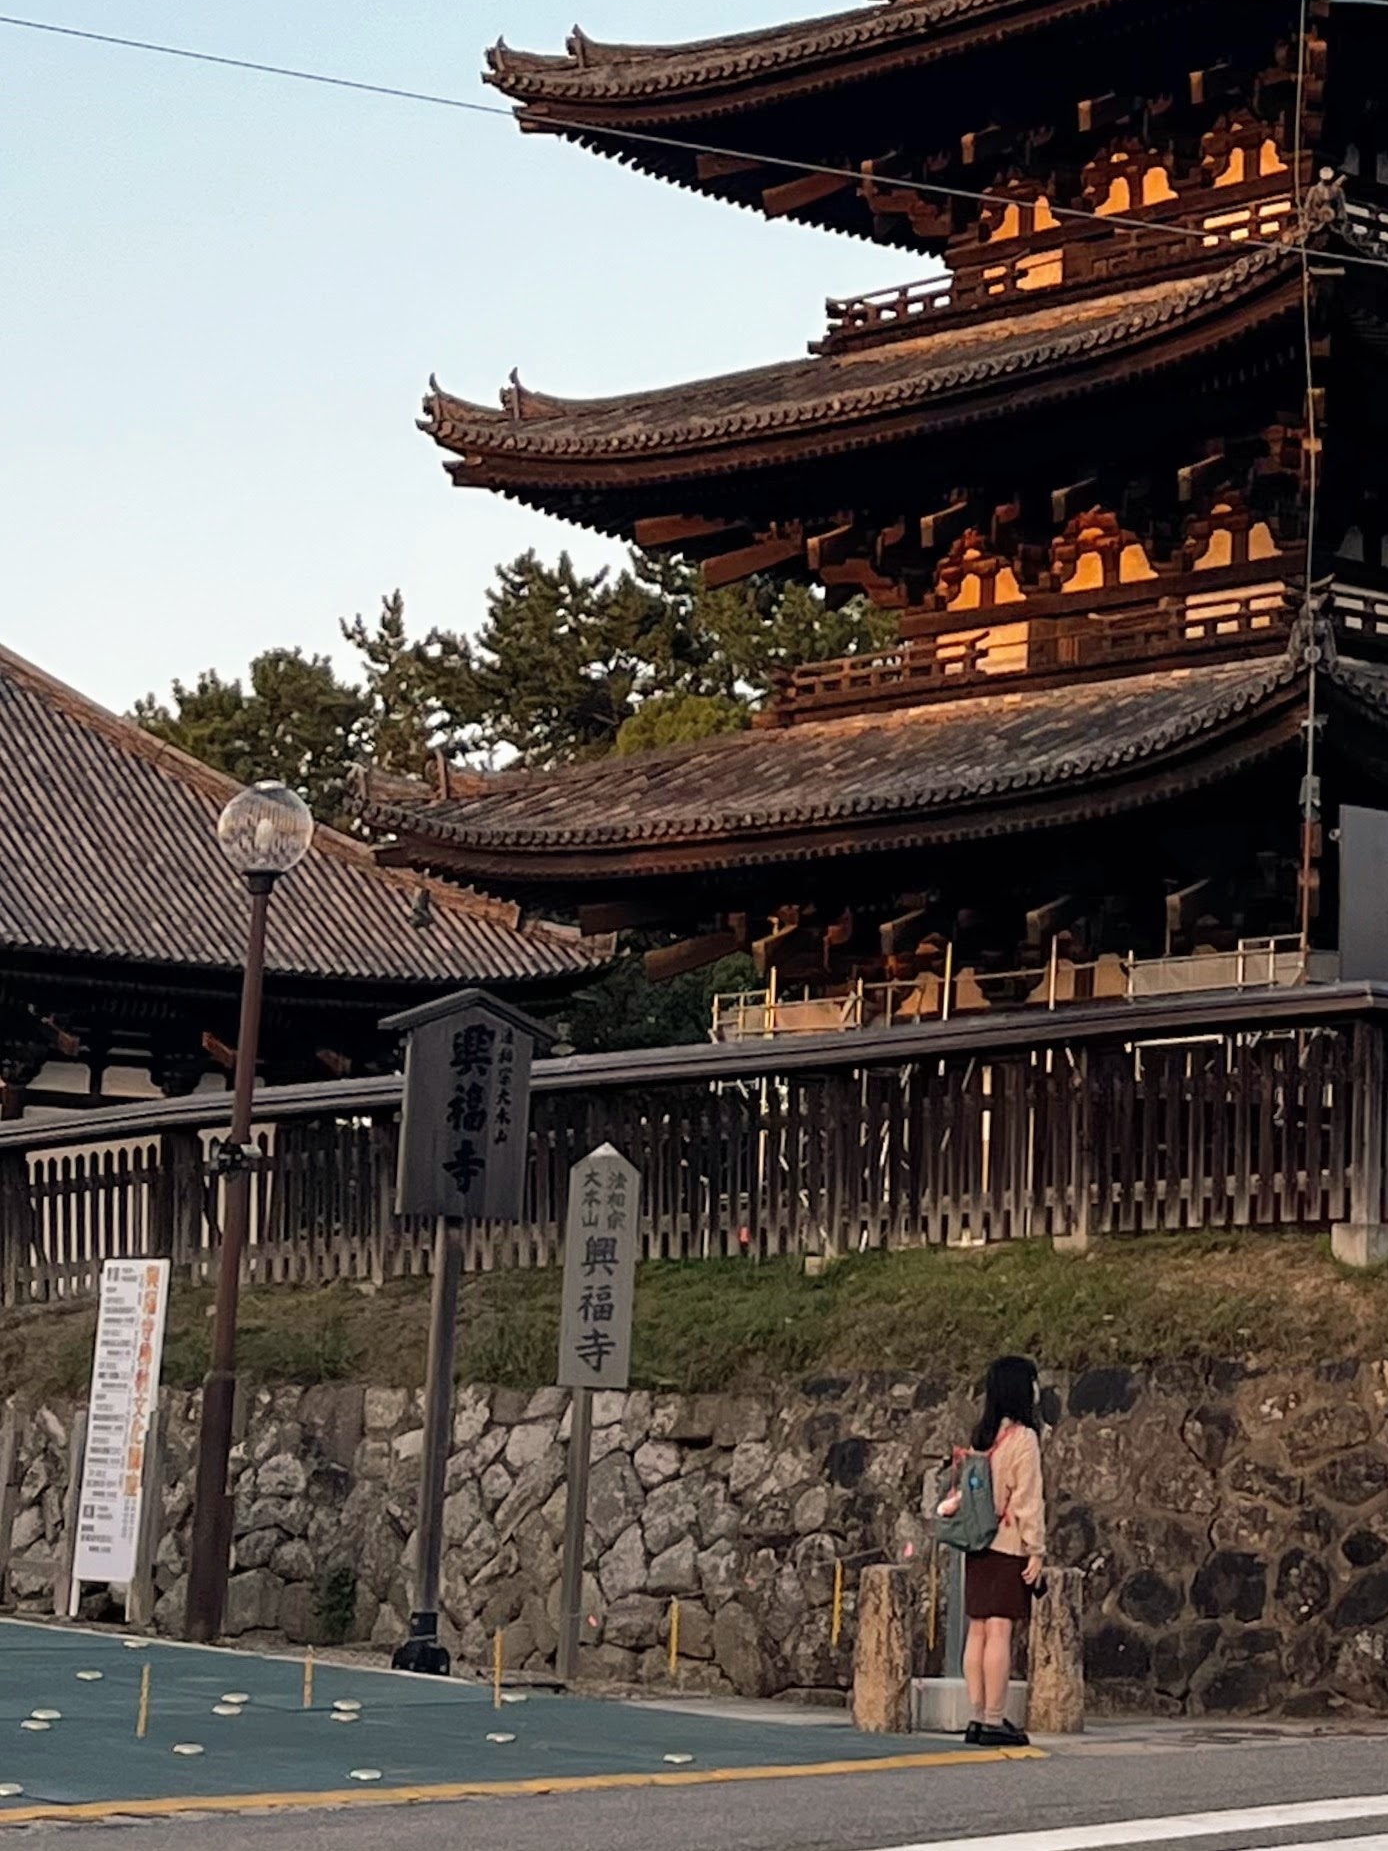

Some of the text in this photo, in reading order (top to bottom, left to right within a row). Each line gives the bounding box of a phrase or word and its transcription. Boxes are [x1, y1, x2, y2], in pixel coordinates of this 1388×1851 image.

[442, 1024, 495, 1194] 興福寺
[581, 1169, 602, 1227] 大本山
[607, 1170, 627, 1230] 法相宗
[574, 1235, 619, 1373] 興福寺
